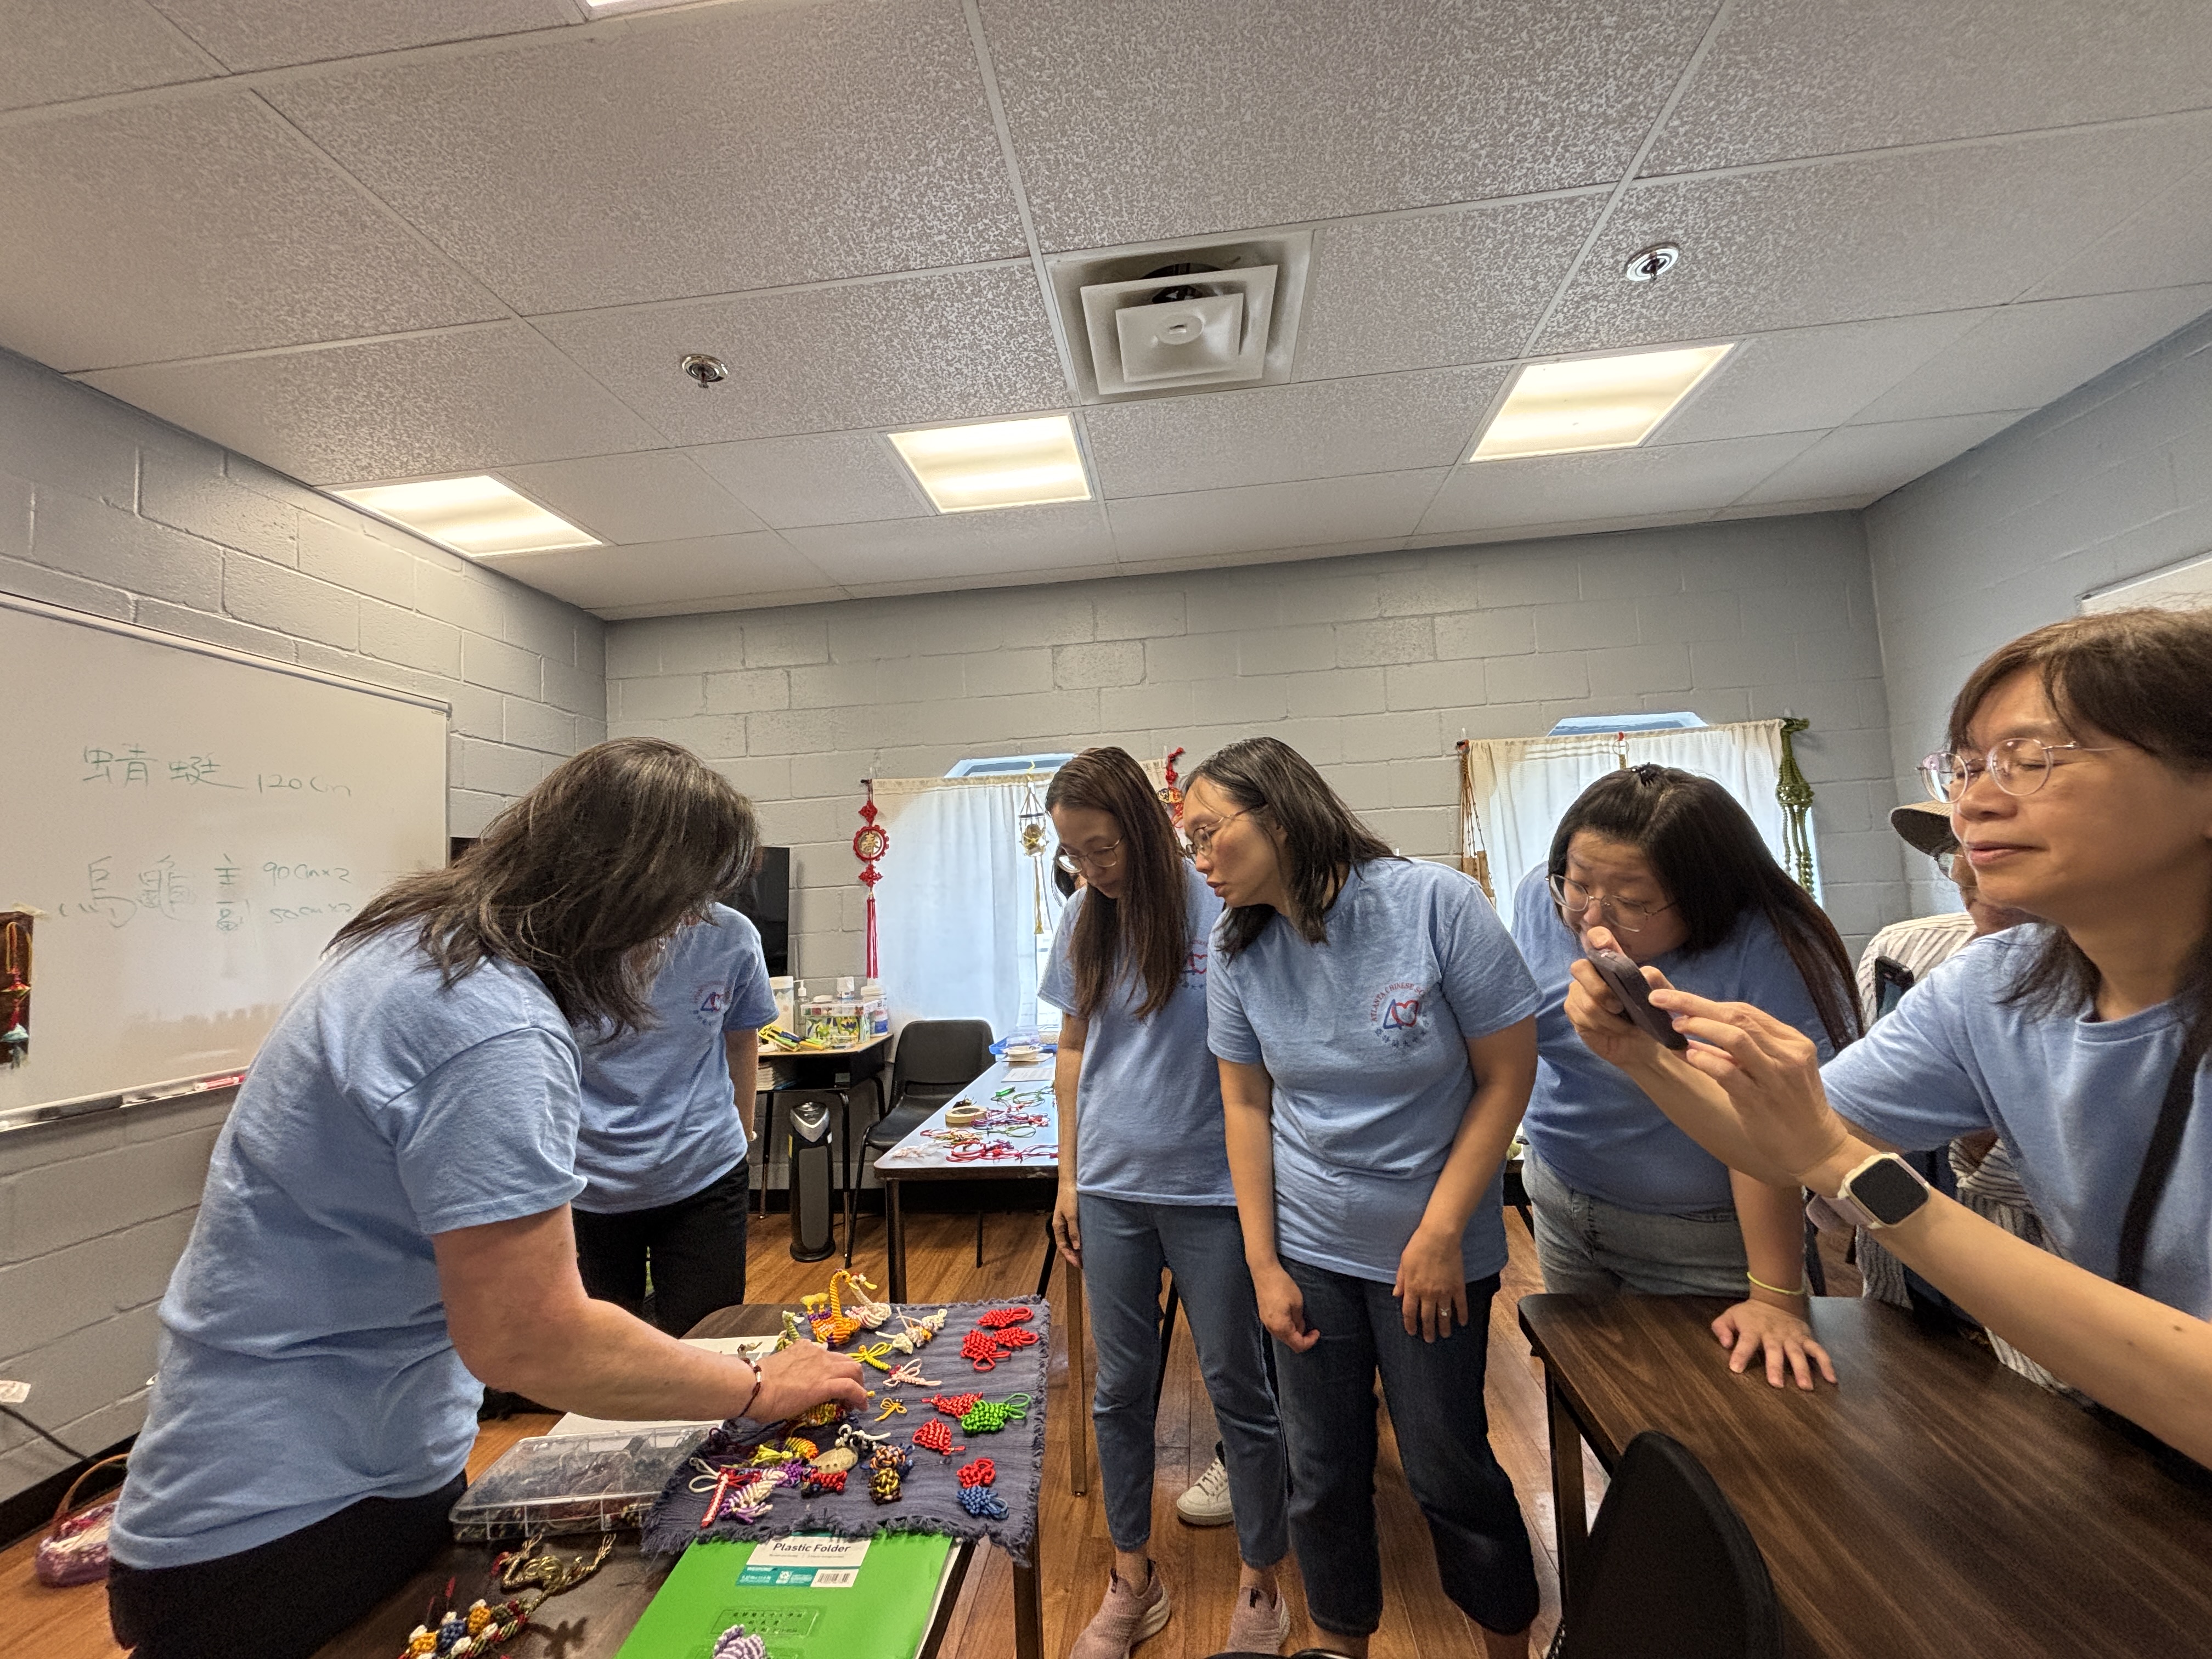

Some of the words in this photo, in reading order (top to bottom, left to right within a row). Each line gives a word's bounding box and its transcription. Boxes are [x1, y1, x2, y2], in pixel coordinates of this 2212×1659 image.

[82, 743, 244, 789] 蜻蜓
[1370, 992, 1386, 1022] ATLANTA
[1385, 982, 1414, 994] CHINESE
[772, 1543, 812, 1552] Plastic
[813, 1544, 851, 1553] Folder
